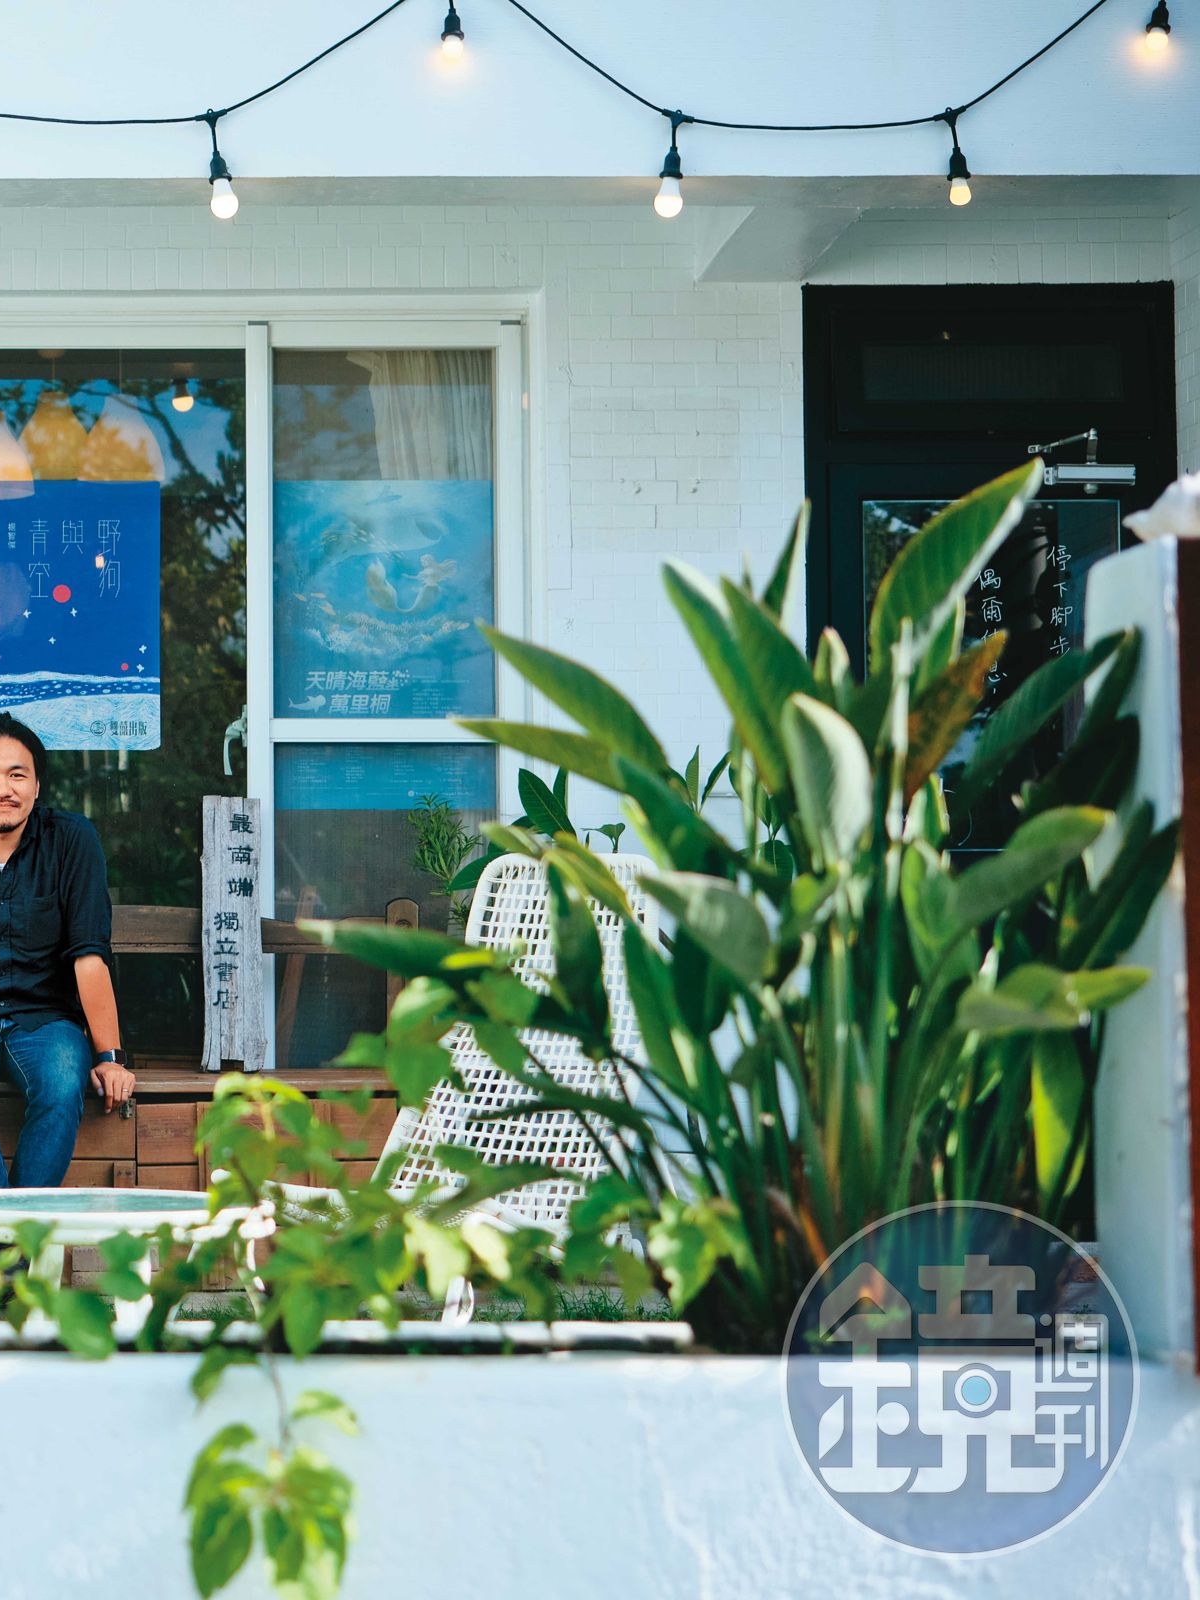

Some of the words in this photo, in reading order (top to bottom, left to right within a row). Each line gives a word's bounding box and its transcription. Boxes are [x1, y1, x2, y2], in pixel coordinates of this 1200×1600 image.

[29, 518, 50, 598] 青空
[62, 519, 84, 554] 與
[98, 519, 121, 598] 野狗
[1046, 545, 1073, 658] 停下腳步
[328, 694, 392, 714] 萬里桐
[227, 813, 254, 898] 最南端
[213, 911, 240, 1010] 獨立書店
